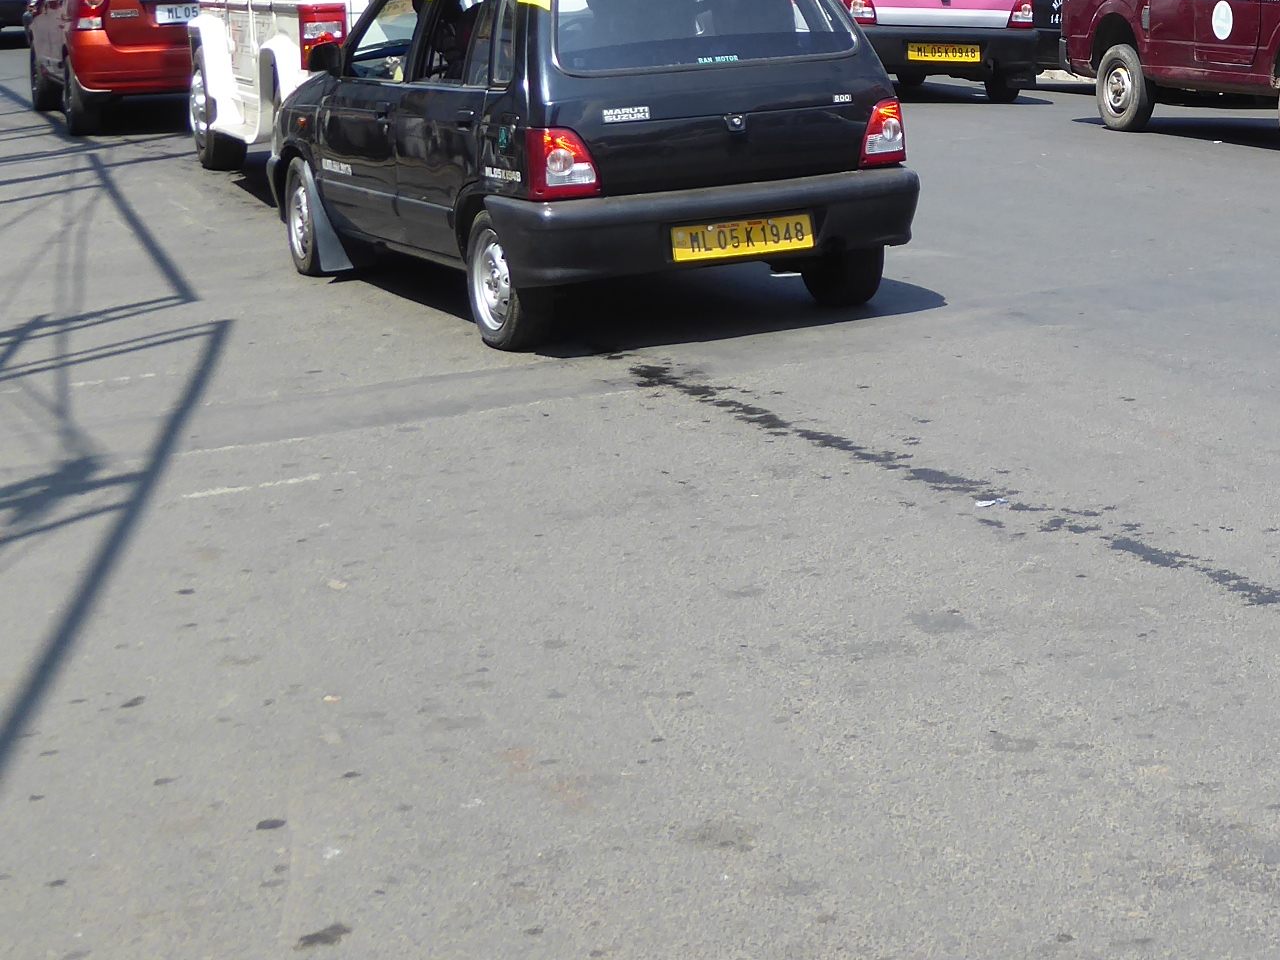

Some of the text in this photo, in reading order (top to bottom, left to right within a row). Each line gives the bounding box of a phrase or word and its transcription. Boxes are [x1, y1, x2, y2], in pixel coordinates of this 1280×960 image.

[714, 54, 739, 63] MOTOR
[834, 94, 850, 103] 800
[603, 106, 649, 116] MARUTI
[604, 113, 650, 122] SUZUKI
